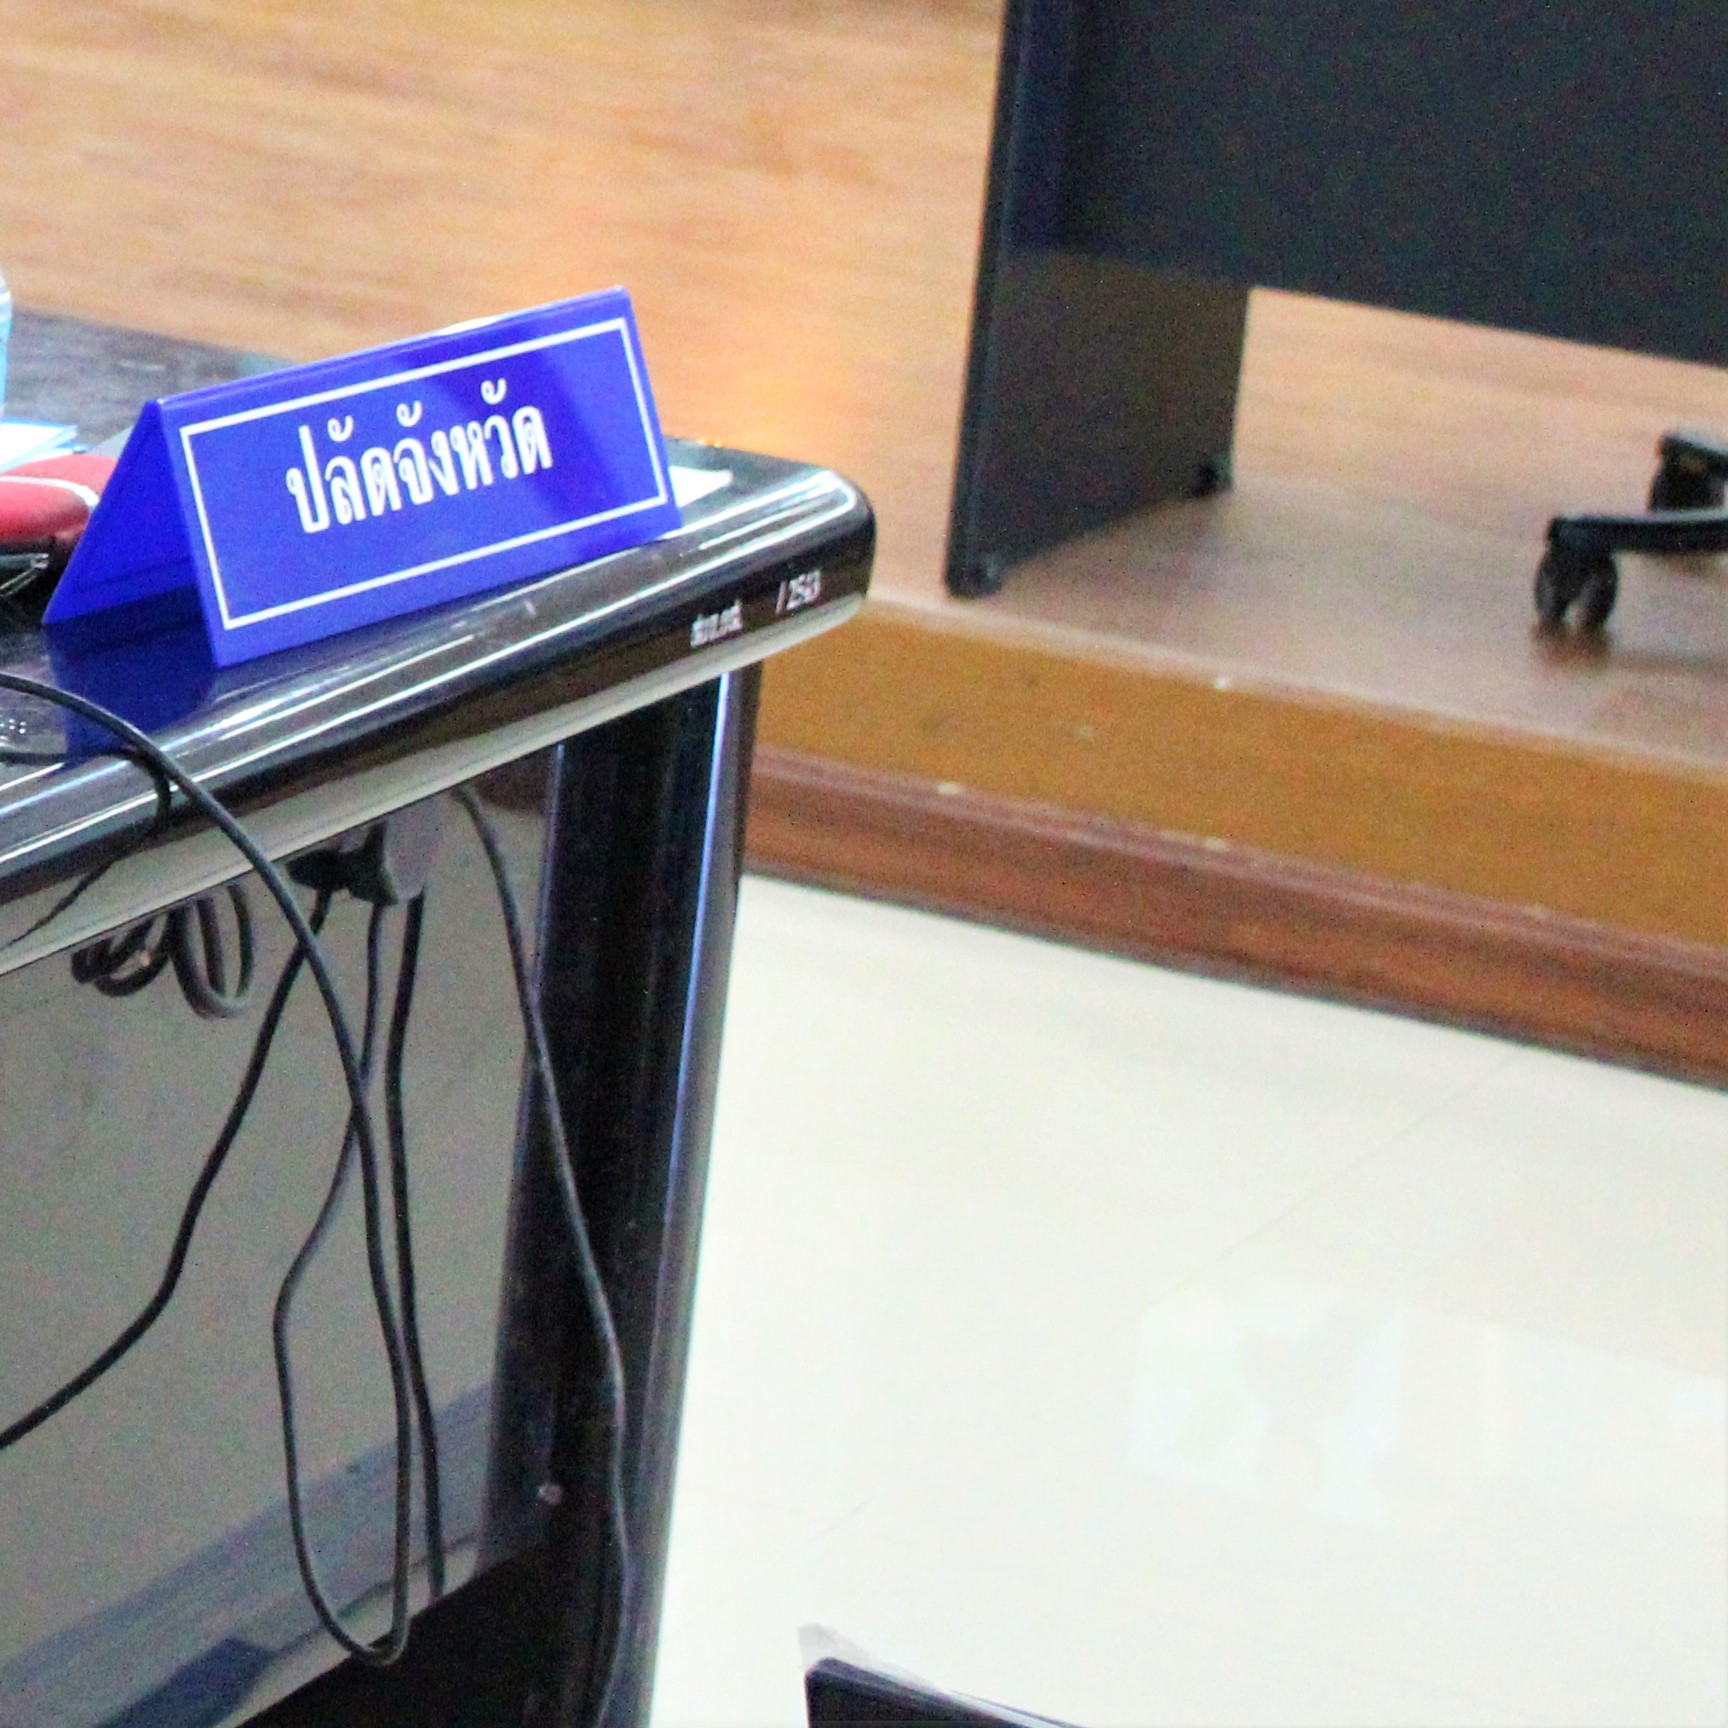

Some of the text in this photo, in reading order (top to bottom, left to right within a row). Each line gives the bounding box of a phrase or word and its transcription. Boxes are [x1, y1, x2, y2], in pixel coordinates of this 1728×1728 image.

[286, 377, 553, 534] ปลัดจังหวัด
